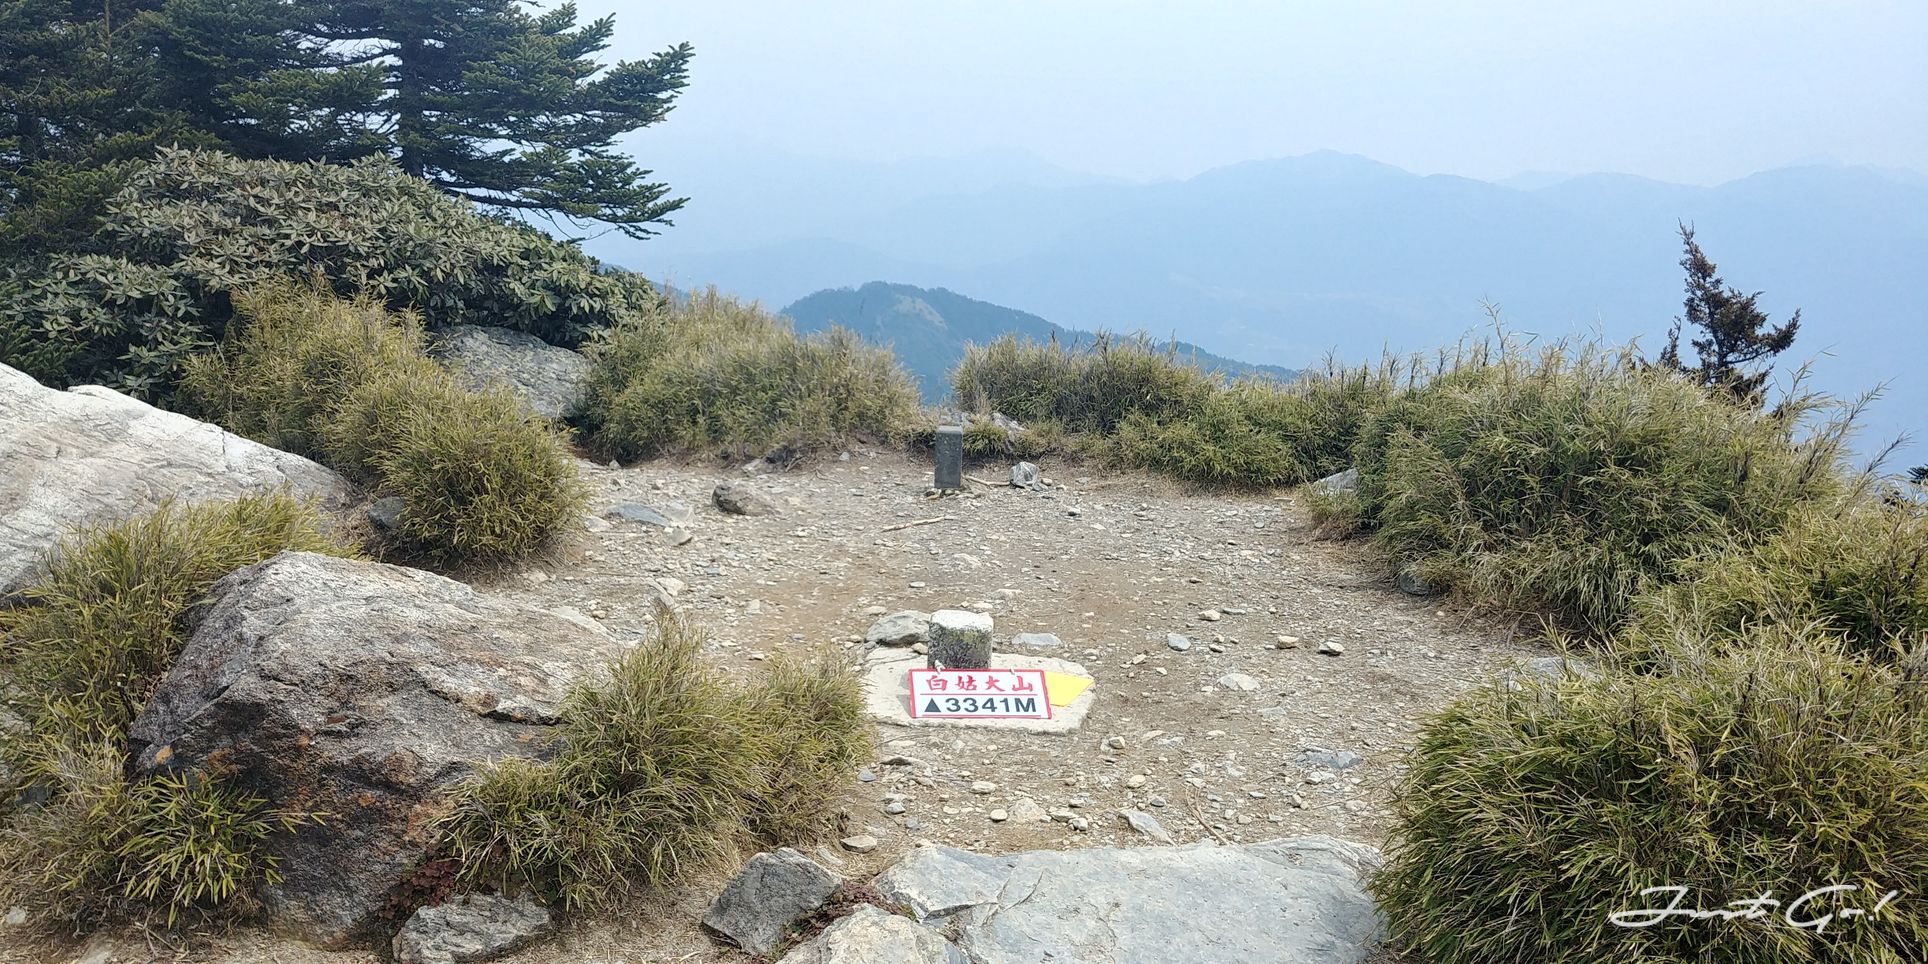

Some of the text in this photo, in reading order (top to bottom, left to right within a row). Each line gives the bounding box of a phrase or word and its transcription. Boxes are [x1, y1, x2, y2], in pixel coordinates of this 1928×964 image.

[926, 675, 1033, 691] 白姑大山
[946, 697, 1036, 712] 3341M
